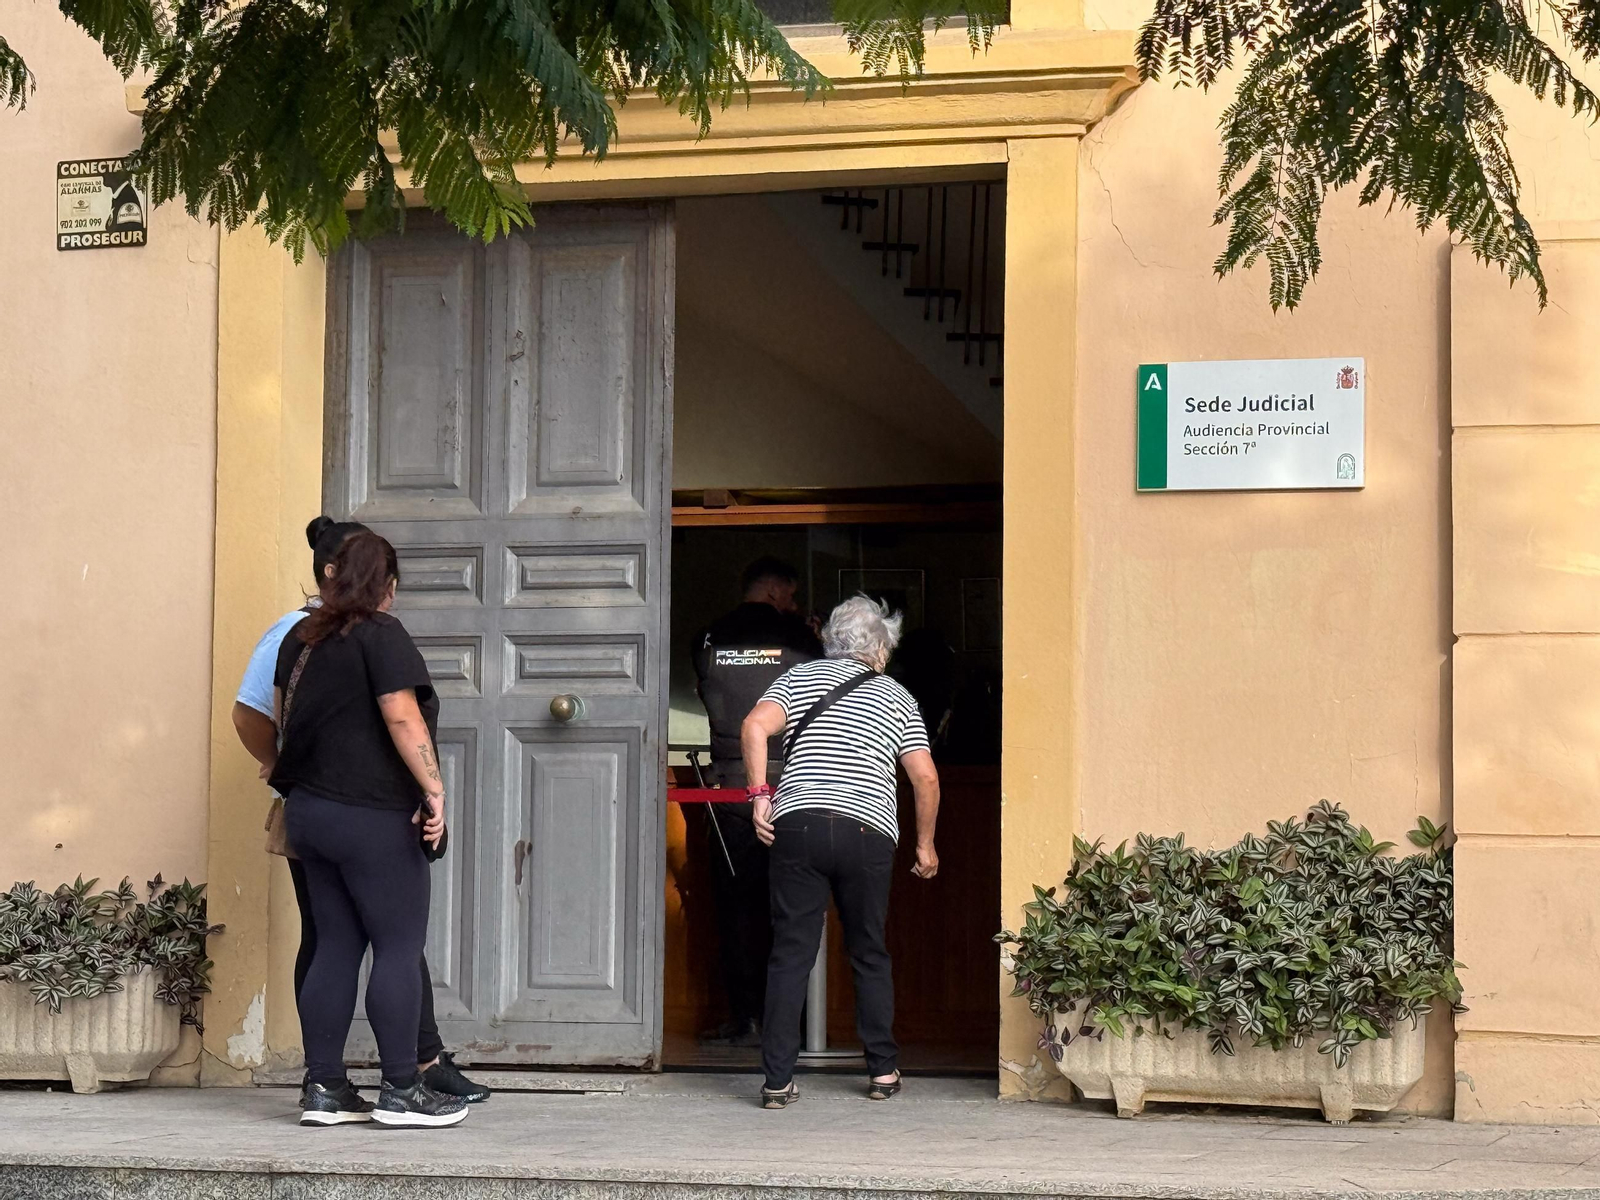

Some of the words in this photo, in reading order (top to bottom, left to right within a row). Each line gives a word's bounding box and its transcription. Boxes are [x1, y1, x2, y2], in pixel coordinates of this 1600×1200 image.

[60, 185, 102, 195] ALARMAS
[60, 219, 73, 229] 902
[75, 218, 87, 228] 202
[61, 231, 144, 248] PROSEGUR
[1184, 395, 1231, 413] Sede
[1237, 393, 1315, 412] Judicial
[1183, 422, 1253, 438] Audiencia
[1257, 421, 1330, 436] Provincial
[1183, 440, 1238, 456] Sección
[717, 657, 780, 665] NACIONAL
